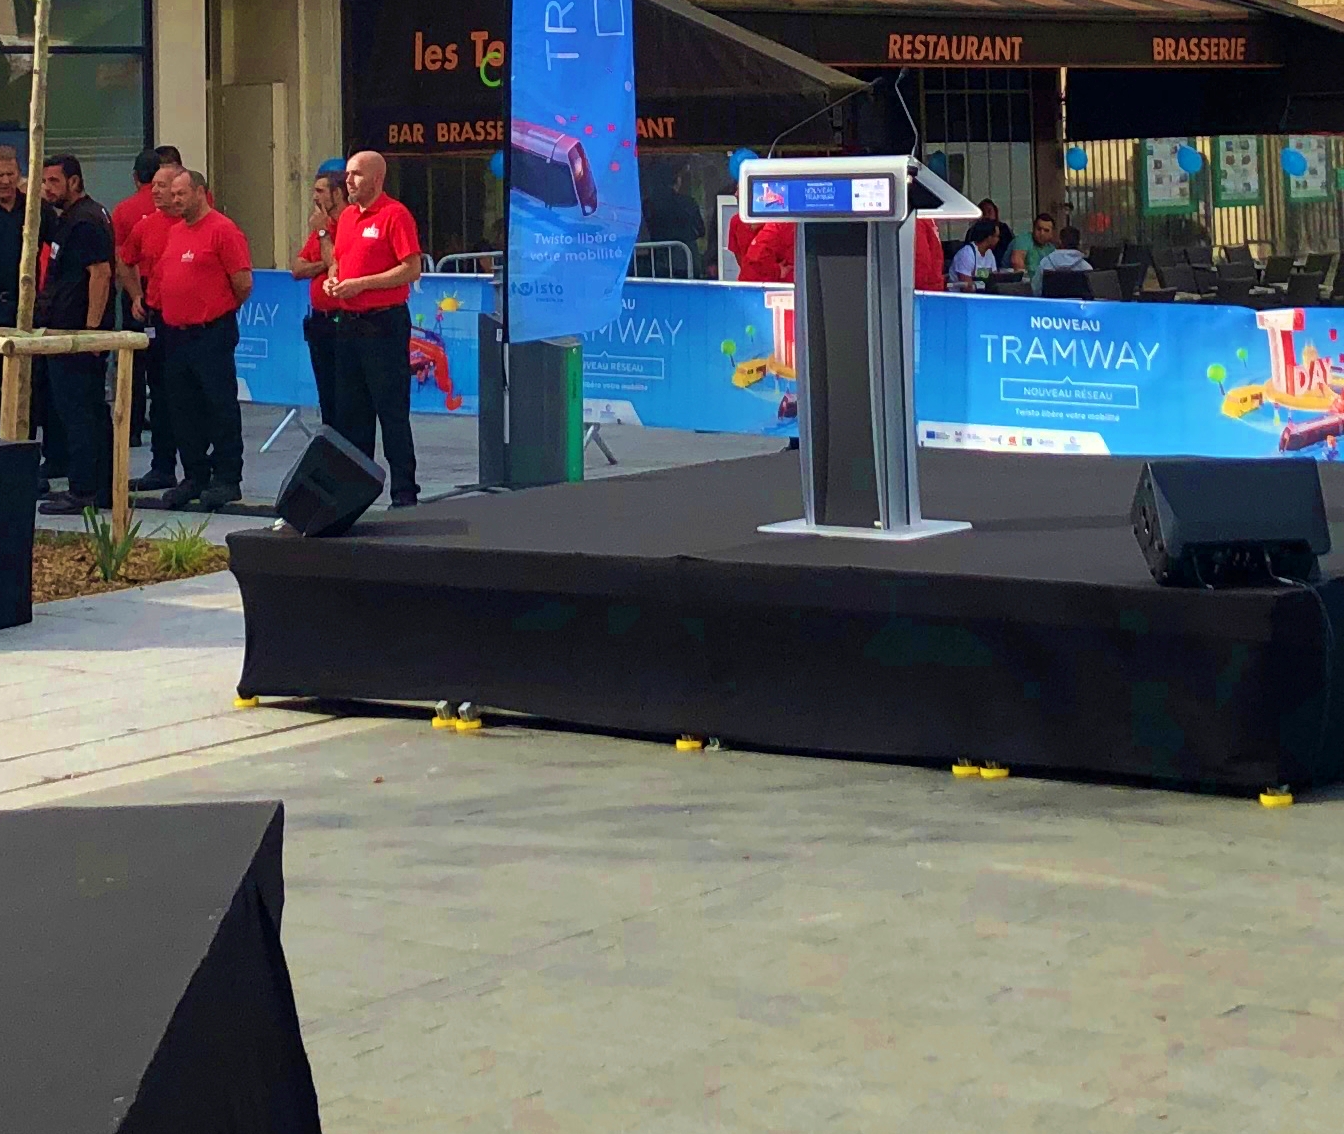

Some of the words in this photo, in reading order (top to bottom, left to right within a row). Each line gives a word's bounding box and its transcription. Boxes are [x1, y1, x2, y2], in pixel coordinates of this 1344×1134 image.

[413, 31, 459, 72] les
[887, 33, 1024, 62] RESTAURANT
[1152, 36, 1247, 62] BRASSERIE
[388, 123, 425, 145] BAR
[534, 232, 574, 245] Twisto
[577, 232, 617, 245] libère
[1030, 316, 1101, 332] NOUVEAU
[979, 334, 1160, 371] TRAMWAY
[1023, 386, 1072, 399] NOUVEAU
[1074, 386, 1113, 400] RÉSEAU
[1015, 407, 1040, 417] Twisto
